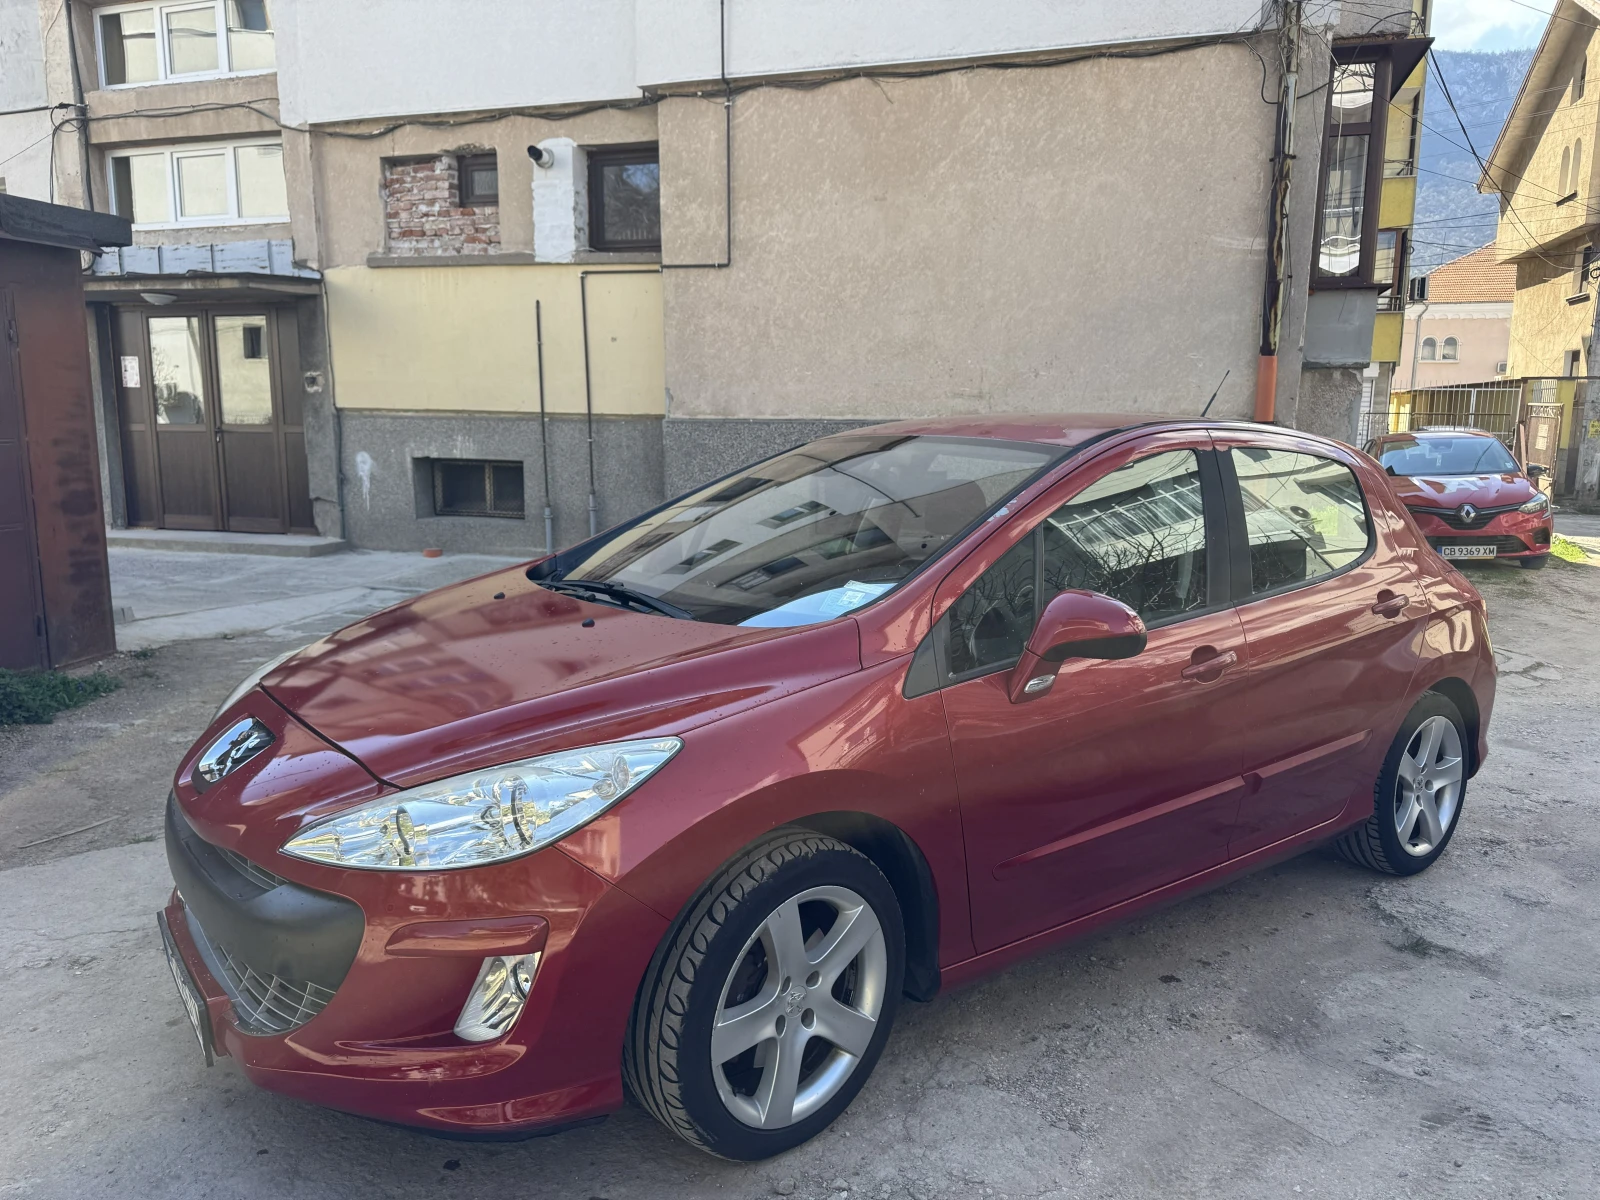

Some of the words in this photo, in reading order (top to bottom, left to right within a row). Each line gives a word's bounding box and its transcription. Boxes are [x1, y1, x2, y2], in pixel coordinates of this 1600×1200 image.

[1443, 547, 1456, 556] CB
[1457, 547, 1481, 556] 9369
[1482, 547, 1495, 556] XM
